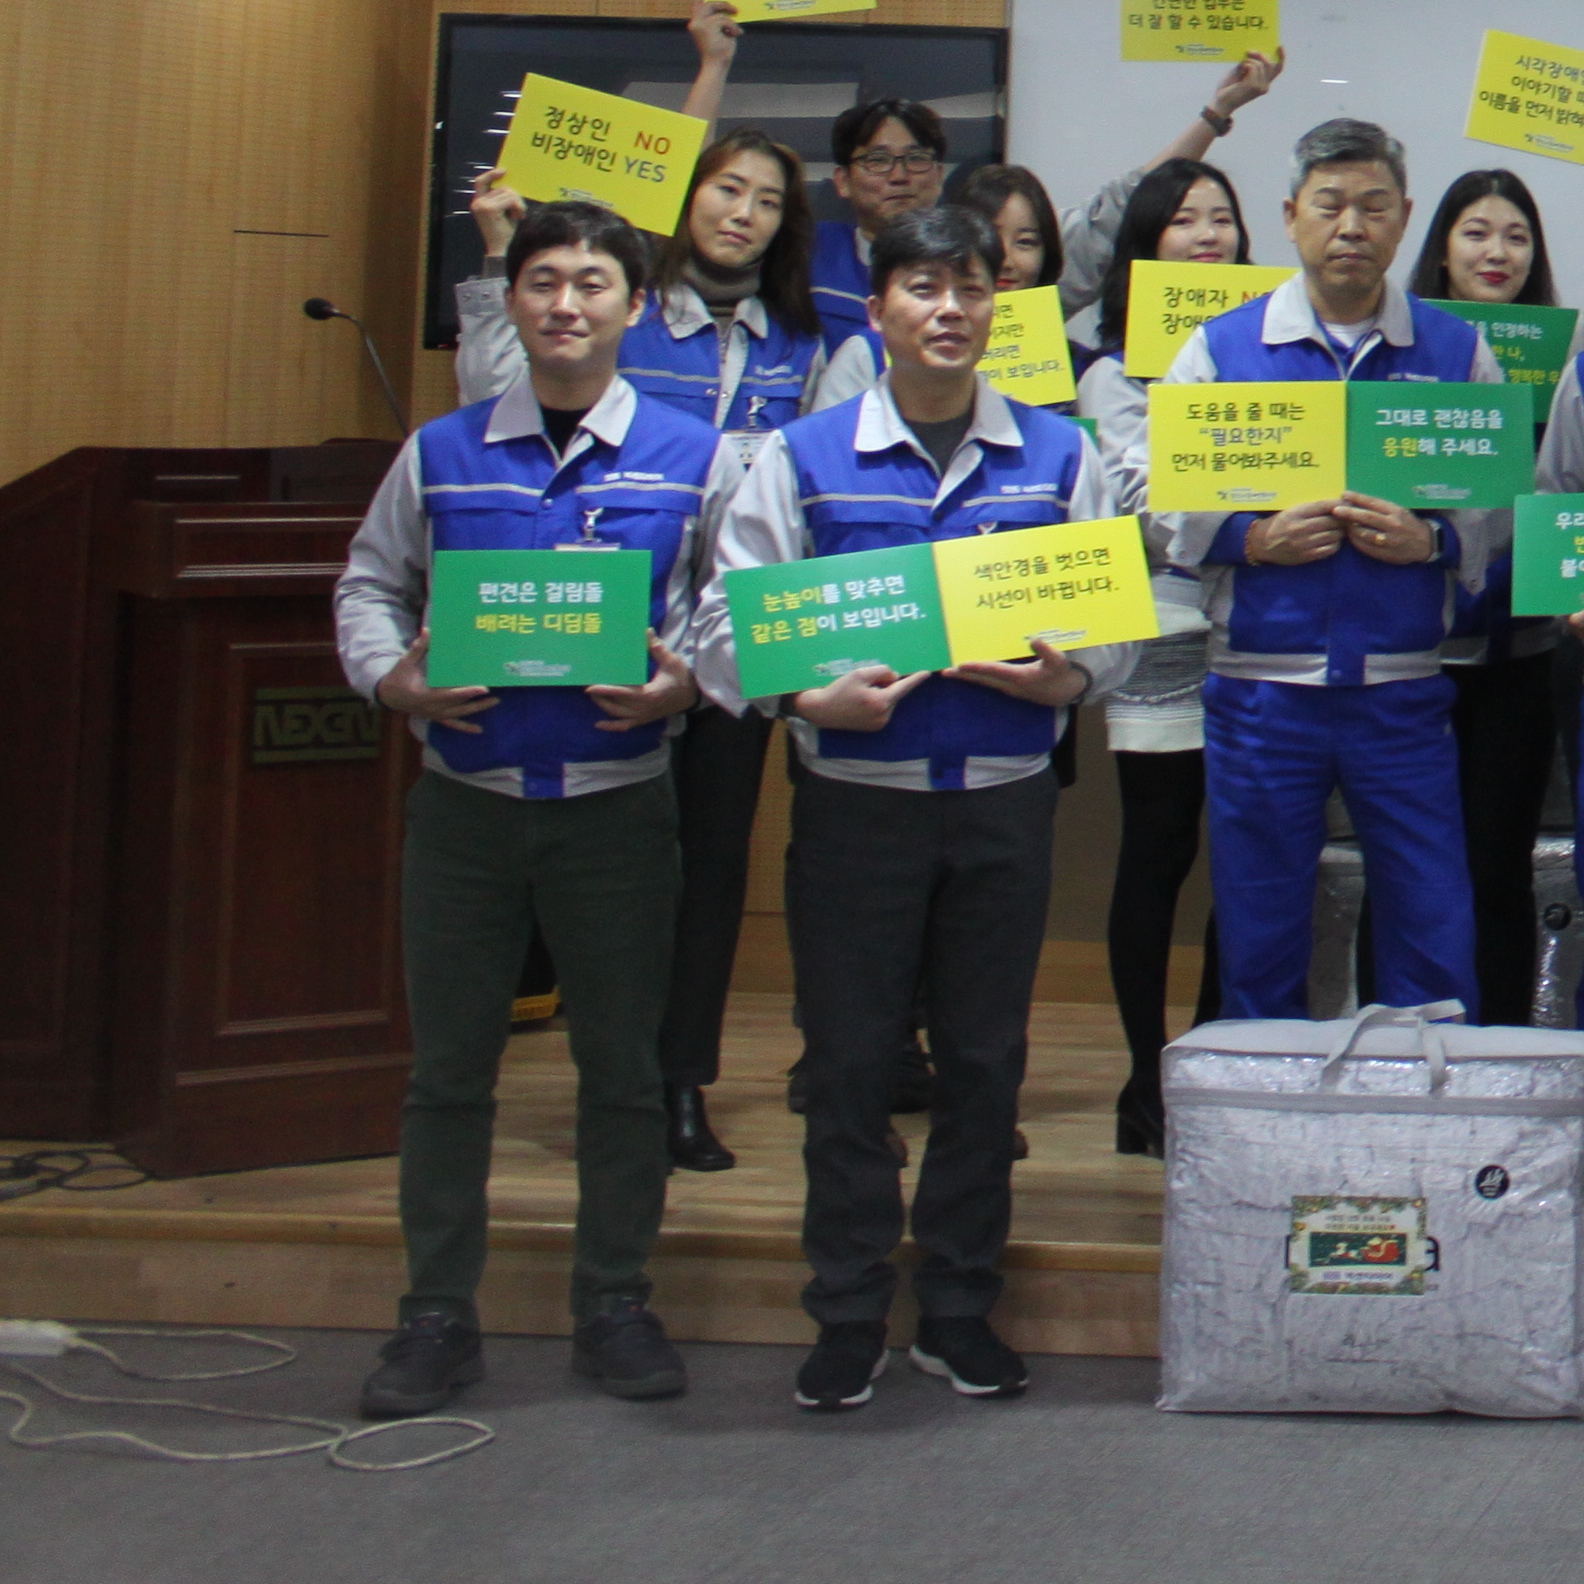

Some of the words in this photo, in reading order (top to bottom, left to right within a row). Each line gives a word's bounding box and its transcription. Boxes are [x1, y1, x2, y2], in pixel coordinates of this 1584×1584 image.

[1129, 14, 1142, 28] 더
[1188, 16, 1201, 29] 수
[1207, 16, 1269, 30] 있습니다.
[1511, 76, 1572, 103] 이야기할
[1479, 91, 1521, 114] 이름을
[1525, 101, 1553, 120] 먼저
[545, 106, 611, 142] 정상인
[634, 131, 671, 154] NO
[531, 131, 617, 172] 비장애인
[624, 156, 667, 182] YES
[1164, 287, 1228, 308] 장애자
[1187, 402, 1239, 421] 도움을
[1247, 402, 1262, 420] 줄
[1270, 402, 1305, 421] 때는
[1376, 409, 1429, 426] 그대로
[1442, 438, 1498, 456] 주세요.
[1173, 453, 1205, 472] 먼저
[975, 556, 1049, 582] 색안경을
[1055, 547, 1111, 571] 벗으면
[478, 582, 538, 603] 편견은
[545, 582, 603, 603] 걸림돌
[763, 584, 841, 613] 눈높이를
[845, 575, 905, 600] 맞추면
[977, 587, 1030, 609] 시선이
[1038, 576, 1119, 600] 바뀝니다.
[475, 614, 536, 634] 배려는
[543, 613, 602, 634] 디딤돌
[752, 620, 792, 645] 같은
[798, 614, 838, 638] 점이
[843, 603, 927, 629] 보입니다.
